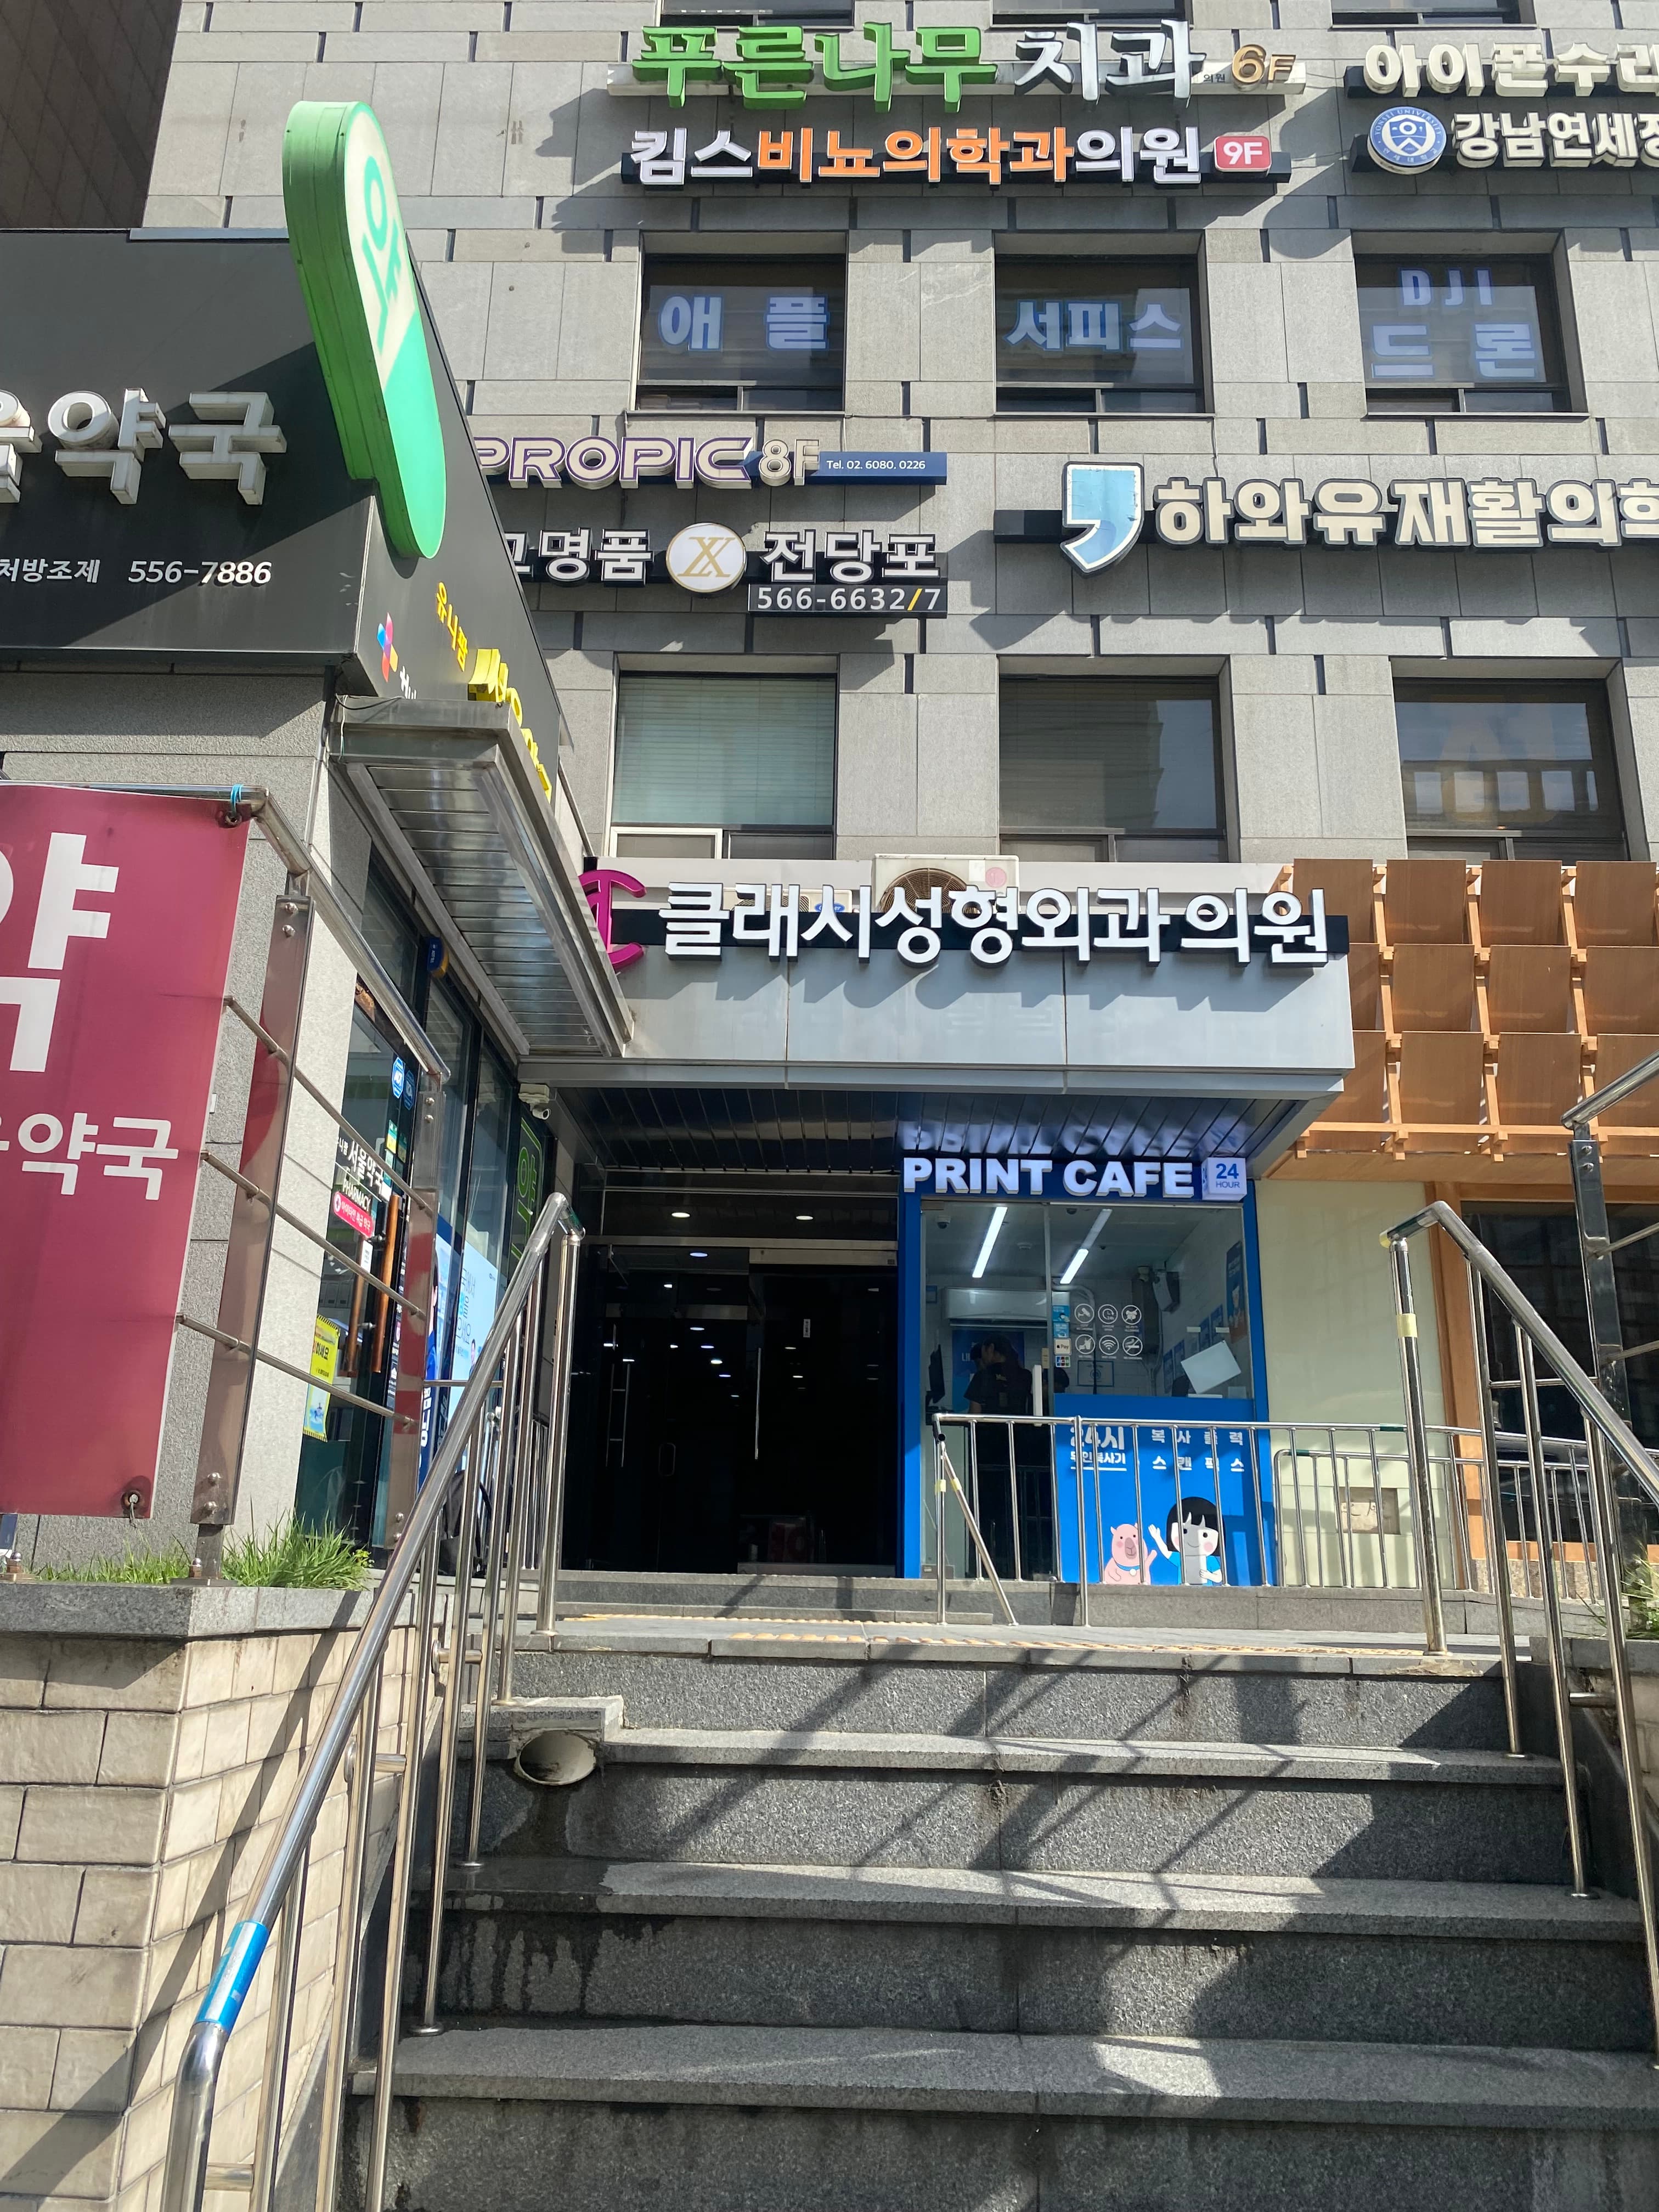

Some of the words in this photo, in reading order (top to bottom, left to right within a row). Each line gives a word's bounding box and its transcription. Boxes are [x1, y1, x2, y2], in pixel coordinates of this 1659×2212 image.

[631, 21, 998, 113] 푸른나무
[1014, 19, 1207, 109] 치과
[1232, 44, 1296, 91] 6F
[1203, 73, 1226, 83] 의원
[1374, 111, 1395, 136] YONSEI
[1396, 109, 1442, 134] UNIVERSITY
[630, 127, 1201, 186] 킴스비뇨의학과의원
[1222, 141, 1263, 165] 9F
[1399, 267, 1493, 306] DJI
[1003, 300, 1183, 352] 서피스
[473, 436, 753, 489] PROPIC
[758, 439, 820, 486] 8F
[826, 459, 844, 470] Tel.
[847, 459, 863, 470] 02.
[865, 459, 896, 471] 6080.
[900, 460, 926, 471] 0226
[0, 558, 101, 584] 처방조제
[127, 560, 273, 585] 556-7886
[759, 529, 941, 584] 전당포
[757, 587, 941, 611] 566-6632/7
[0, 1112, 179, 1200] 약국
[1216, 1163, 1239, 1180] 24
[342, 1178, 371, 1212] PHARMACY
[903, 1157, 1053, 1194] PRINT
[1063, 1160, 1195, 1198] CAFE
[1070, 1426, 1125, 1450] 24시
